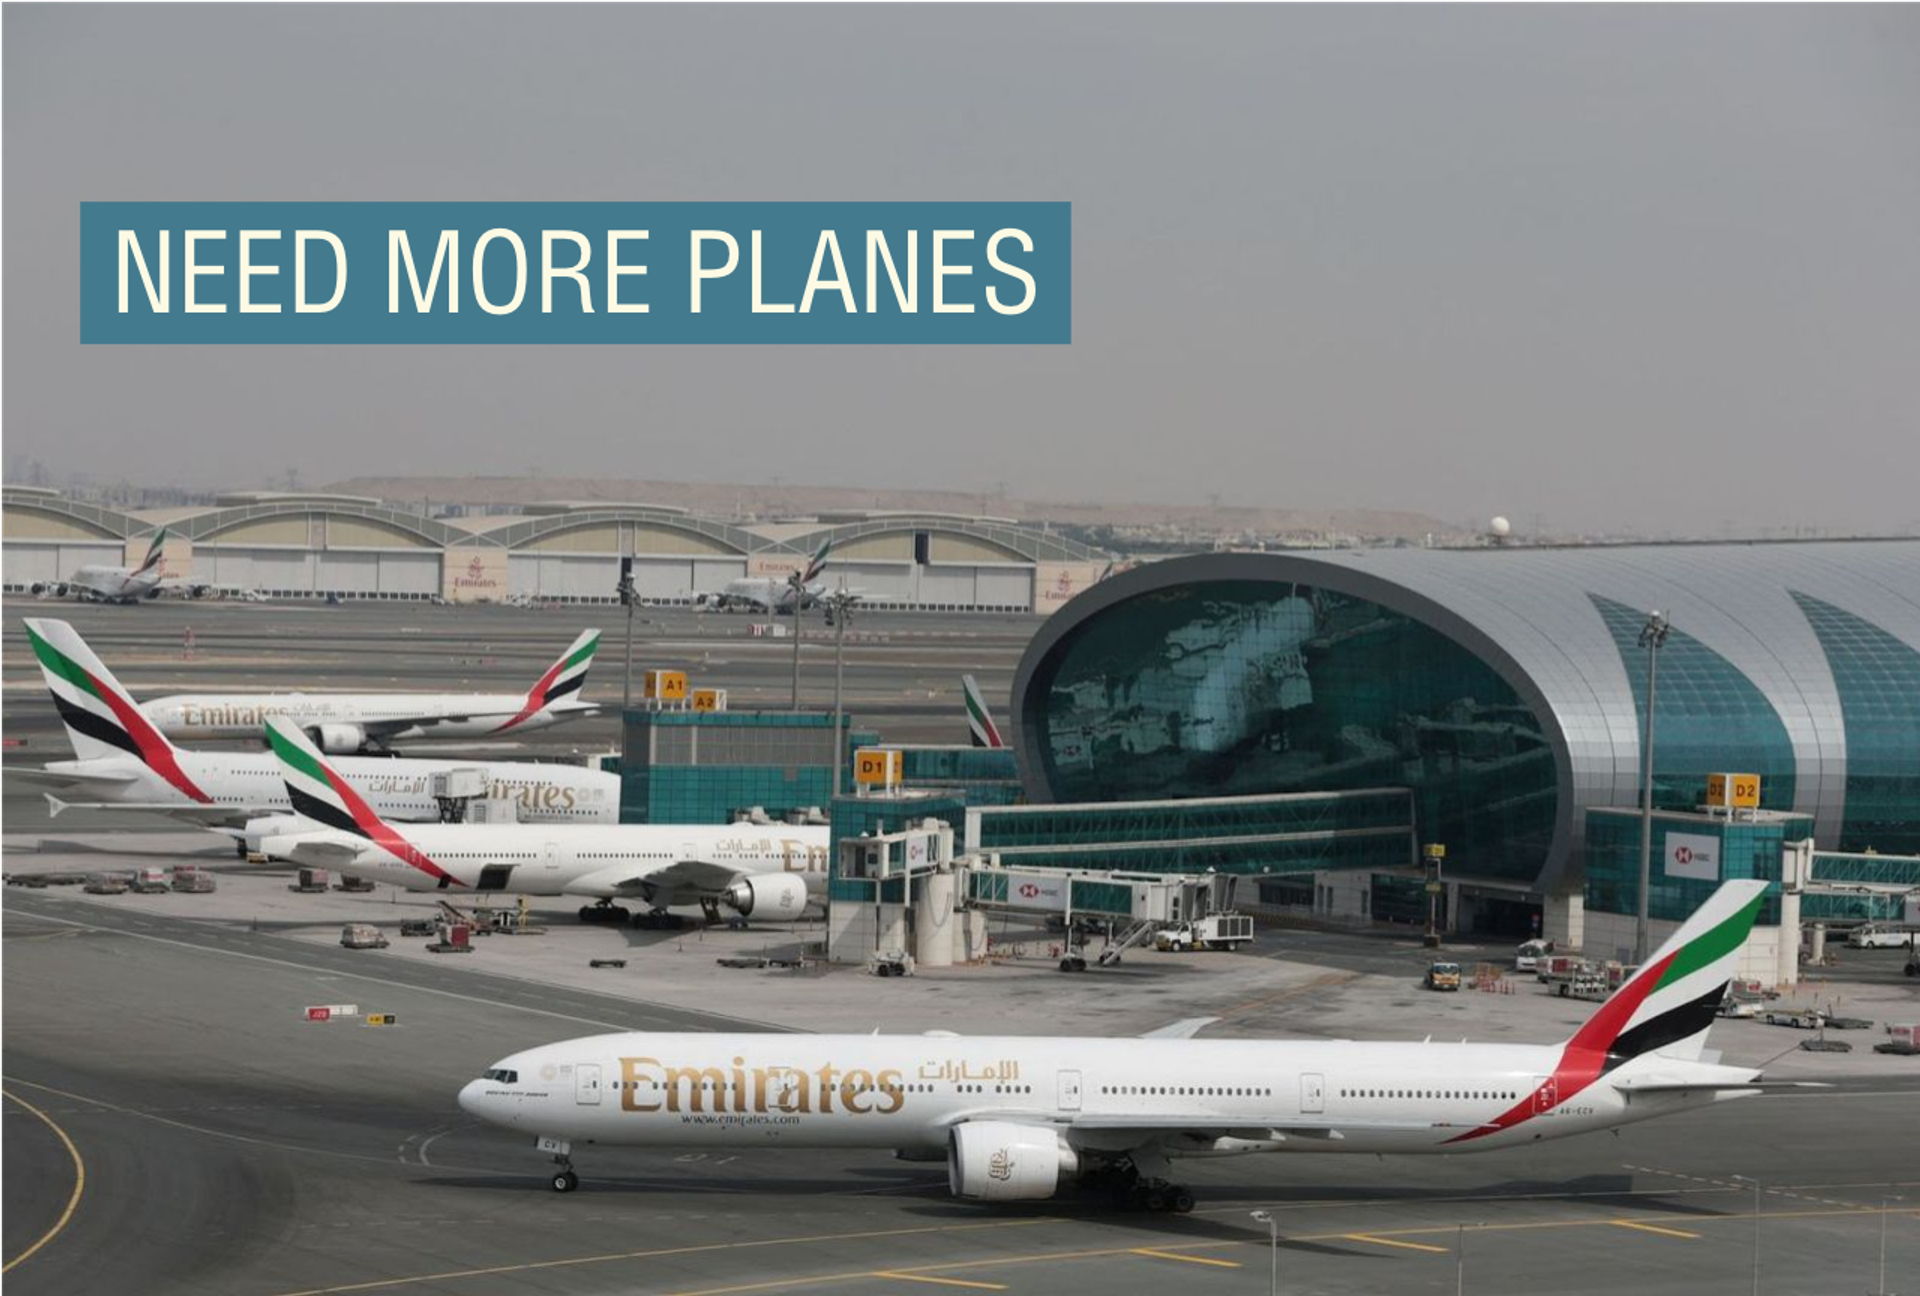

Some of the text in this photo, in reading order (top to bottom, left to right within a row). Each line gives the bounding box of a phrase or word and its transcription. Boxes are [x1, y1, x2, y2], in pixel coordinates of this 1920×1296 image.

[454, 577, 497, 588] Emirates
[666, 679, 683, 691] A1
[697, 697, 714, 708] A2
[862, 760, 882, 773] D1
[1736, 784, 1755, 798] D2
[918, 1059, 1019, 1084] الإمارات
[618, 1056, 905, 1115] Emirates
[681, 1113, 800, 1127] www.emirates.com
